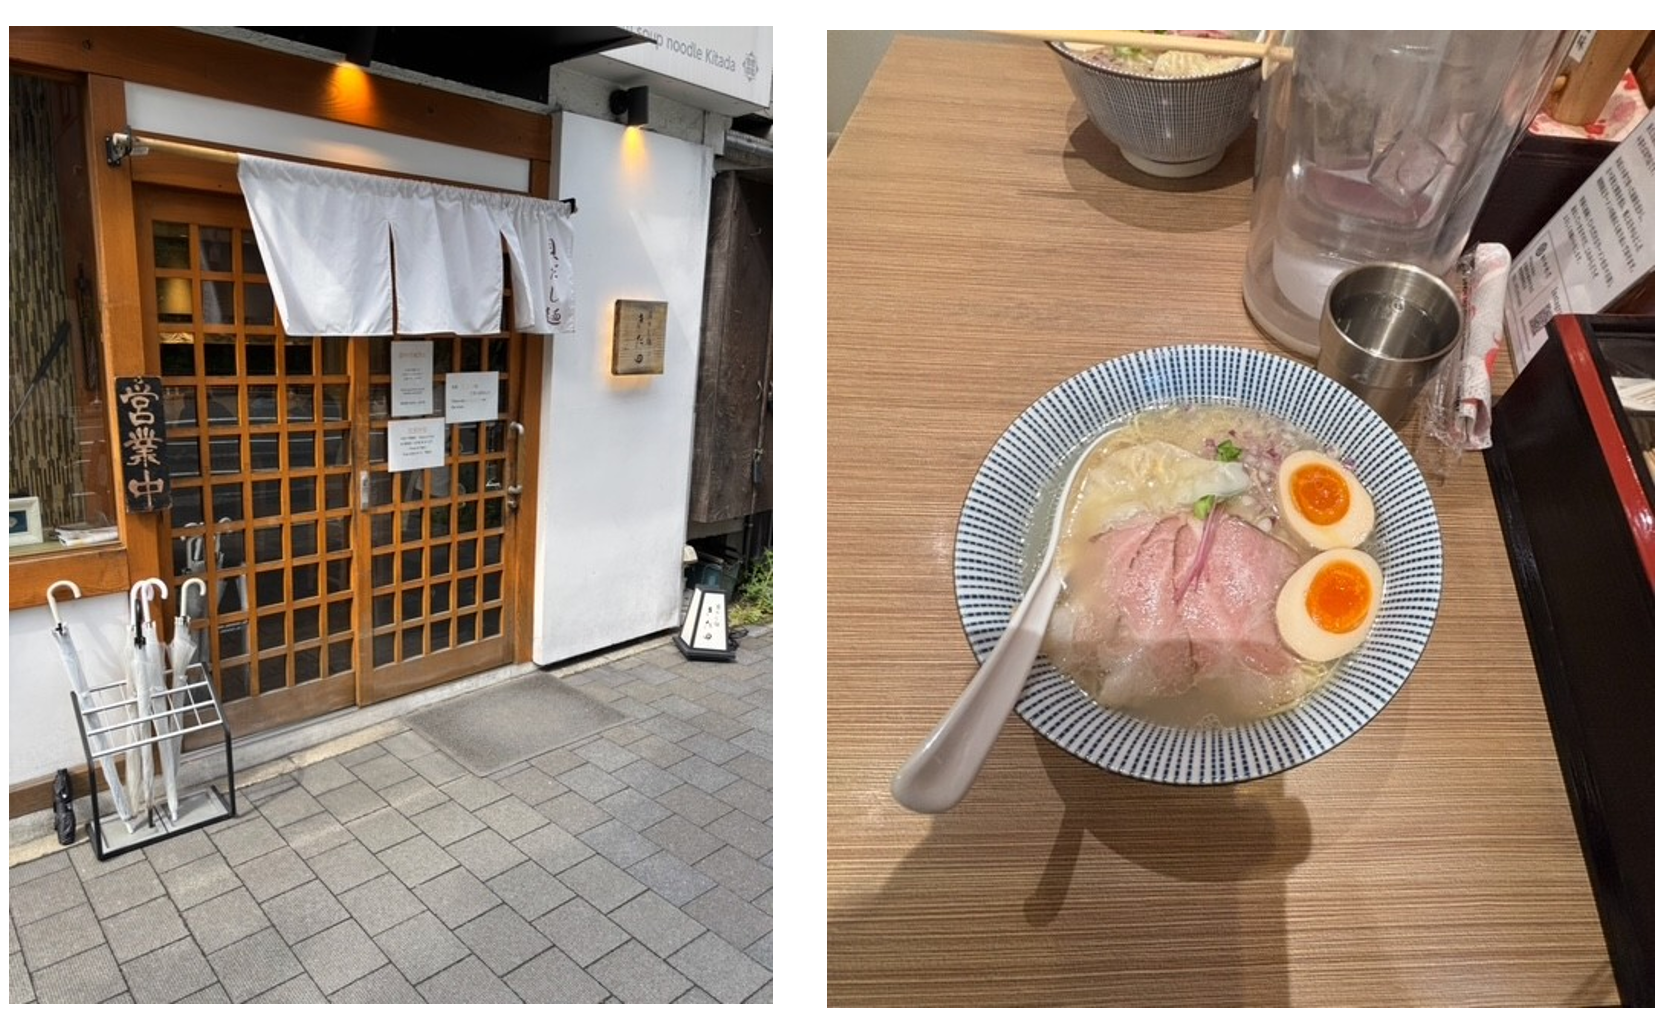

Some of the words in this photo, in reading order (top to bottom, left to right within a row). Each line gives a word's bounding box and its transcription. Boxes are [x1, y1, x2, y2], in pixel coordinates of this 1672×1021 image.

[636, 27, 664, 51] soup
[666, 37, 703, 61] noodle
[705, 48, 736, 72] Kitada
[119, 384, 165, 509] 営業中
